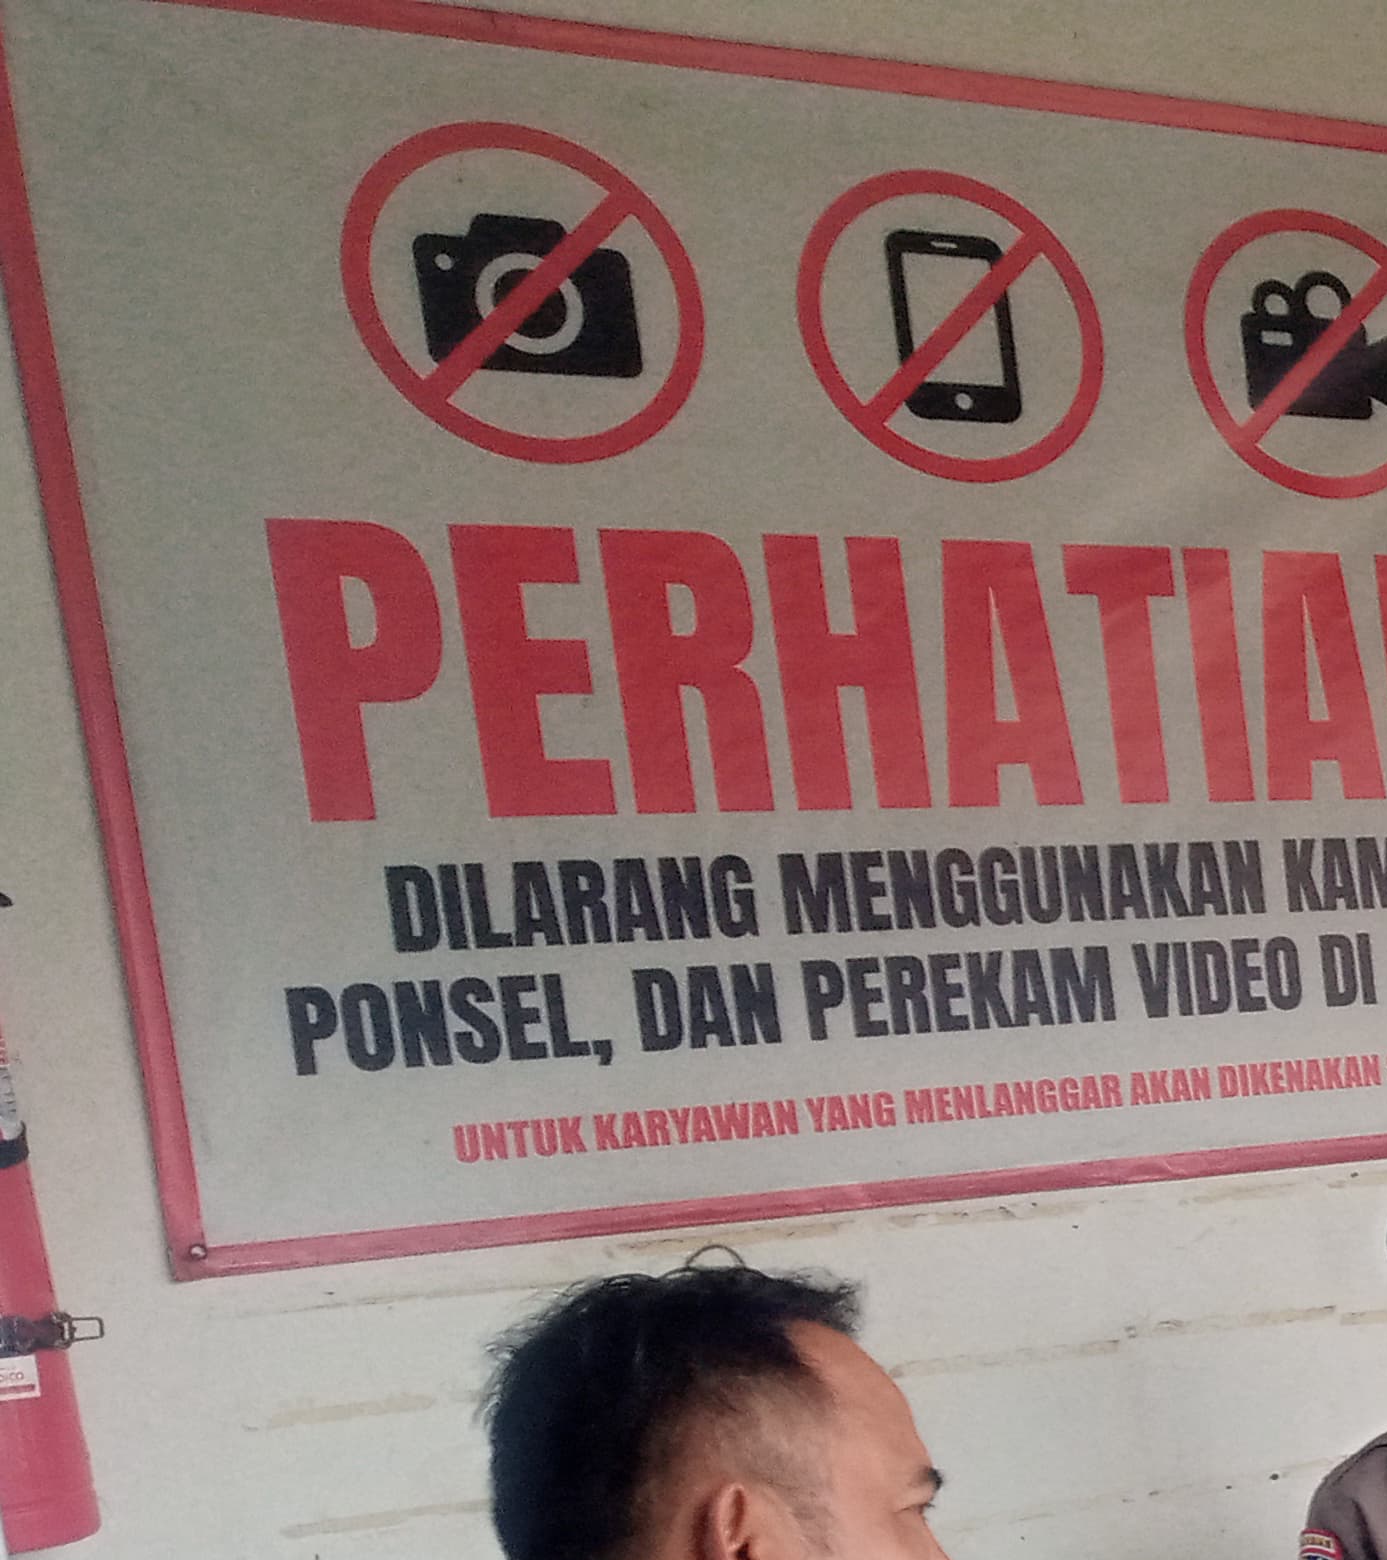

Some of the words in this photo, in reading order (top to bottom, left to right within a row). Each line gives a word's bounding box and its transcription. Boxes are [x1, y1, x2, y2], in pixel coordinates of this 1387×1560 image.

[384, 854, 759, 952] DILARANG
[777, 839, 1267, 934] MENGGUNAKAN
[284, 972, 614, 1076] PONSEL,
[631, 961, 783, 1052] DAN
[800, 943, 1118, 1038] PEREKAM
[1131, 935, 1301, 1019] VIDEO
[1319, 931, 1378, 1008] DI
[452, 1115, 588, 1163] UNTUK
[593, 1099, 800, 1151] KARYAWAN
[804, 1091, 897, 1133] YANG
[903, 1073, 1124, 1125] MENLANGGAR
[1130, 1065, 1212, 1106] AKAN
[1217, 1053, 1383, 1099] DIKENAKAN
